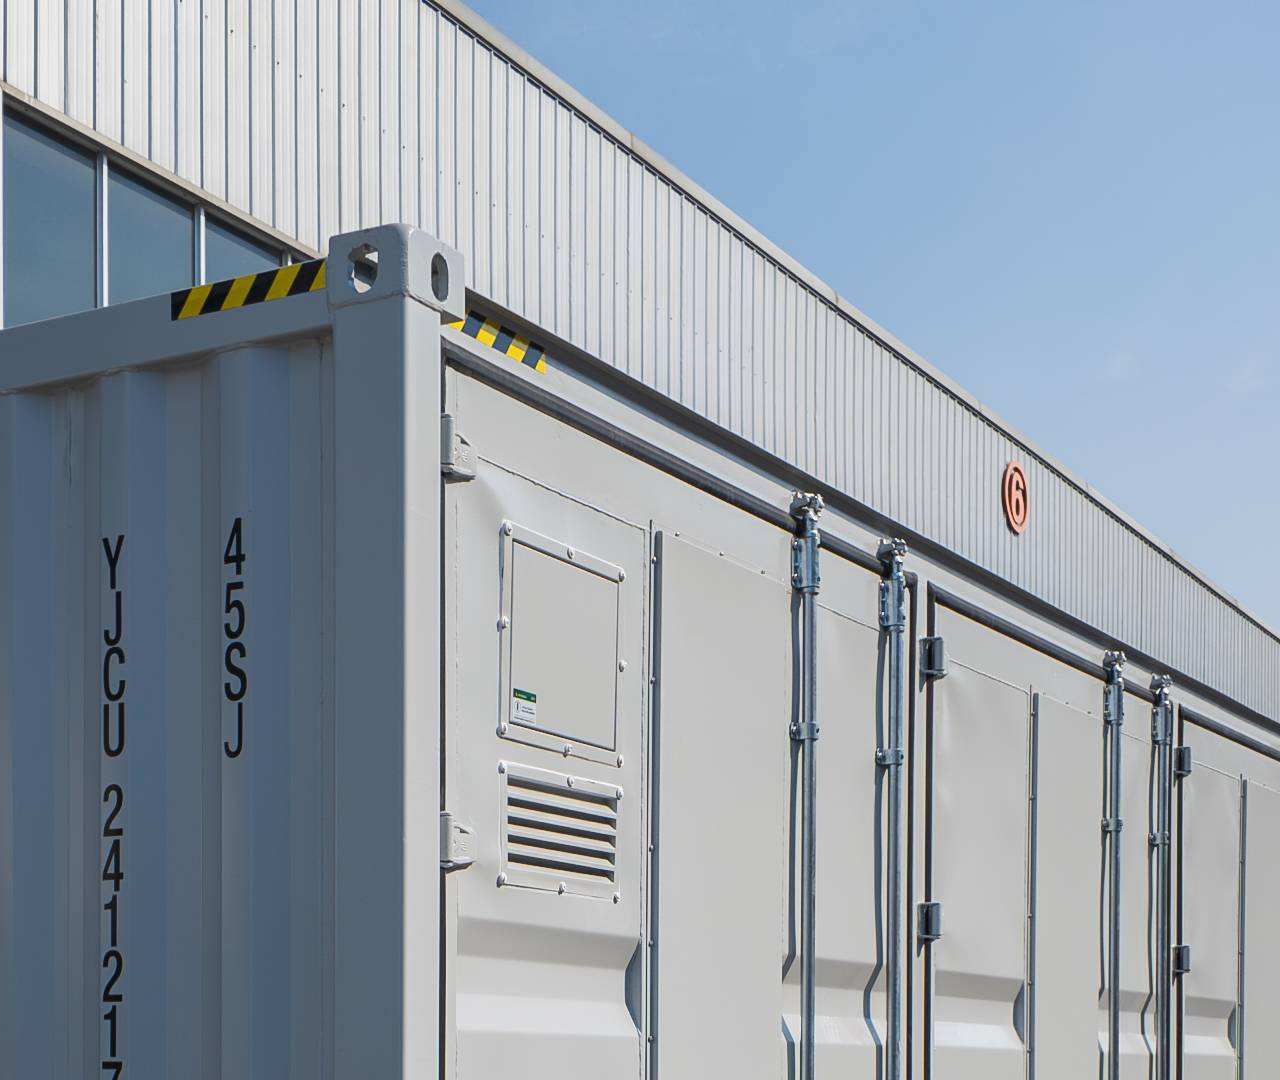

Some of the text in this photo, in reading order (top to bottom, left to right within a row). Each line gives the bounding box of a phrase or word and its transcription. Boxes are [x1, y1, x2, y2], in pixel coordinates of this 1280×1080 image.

[1011, 471, 1025, 525] 6
[102, 534, 125, 757] YJCU
[224, 517, 247, 758] 45SJ
